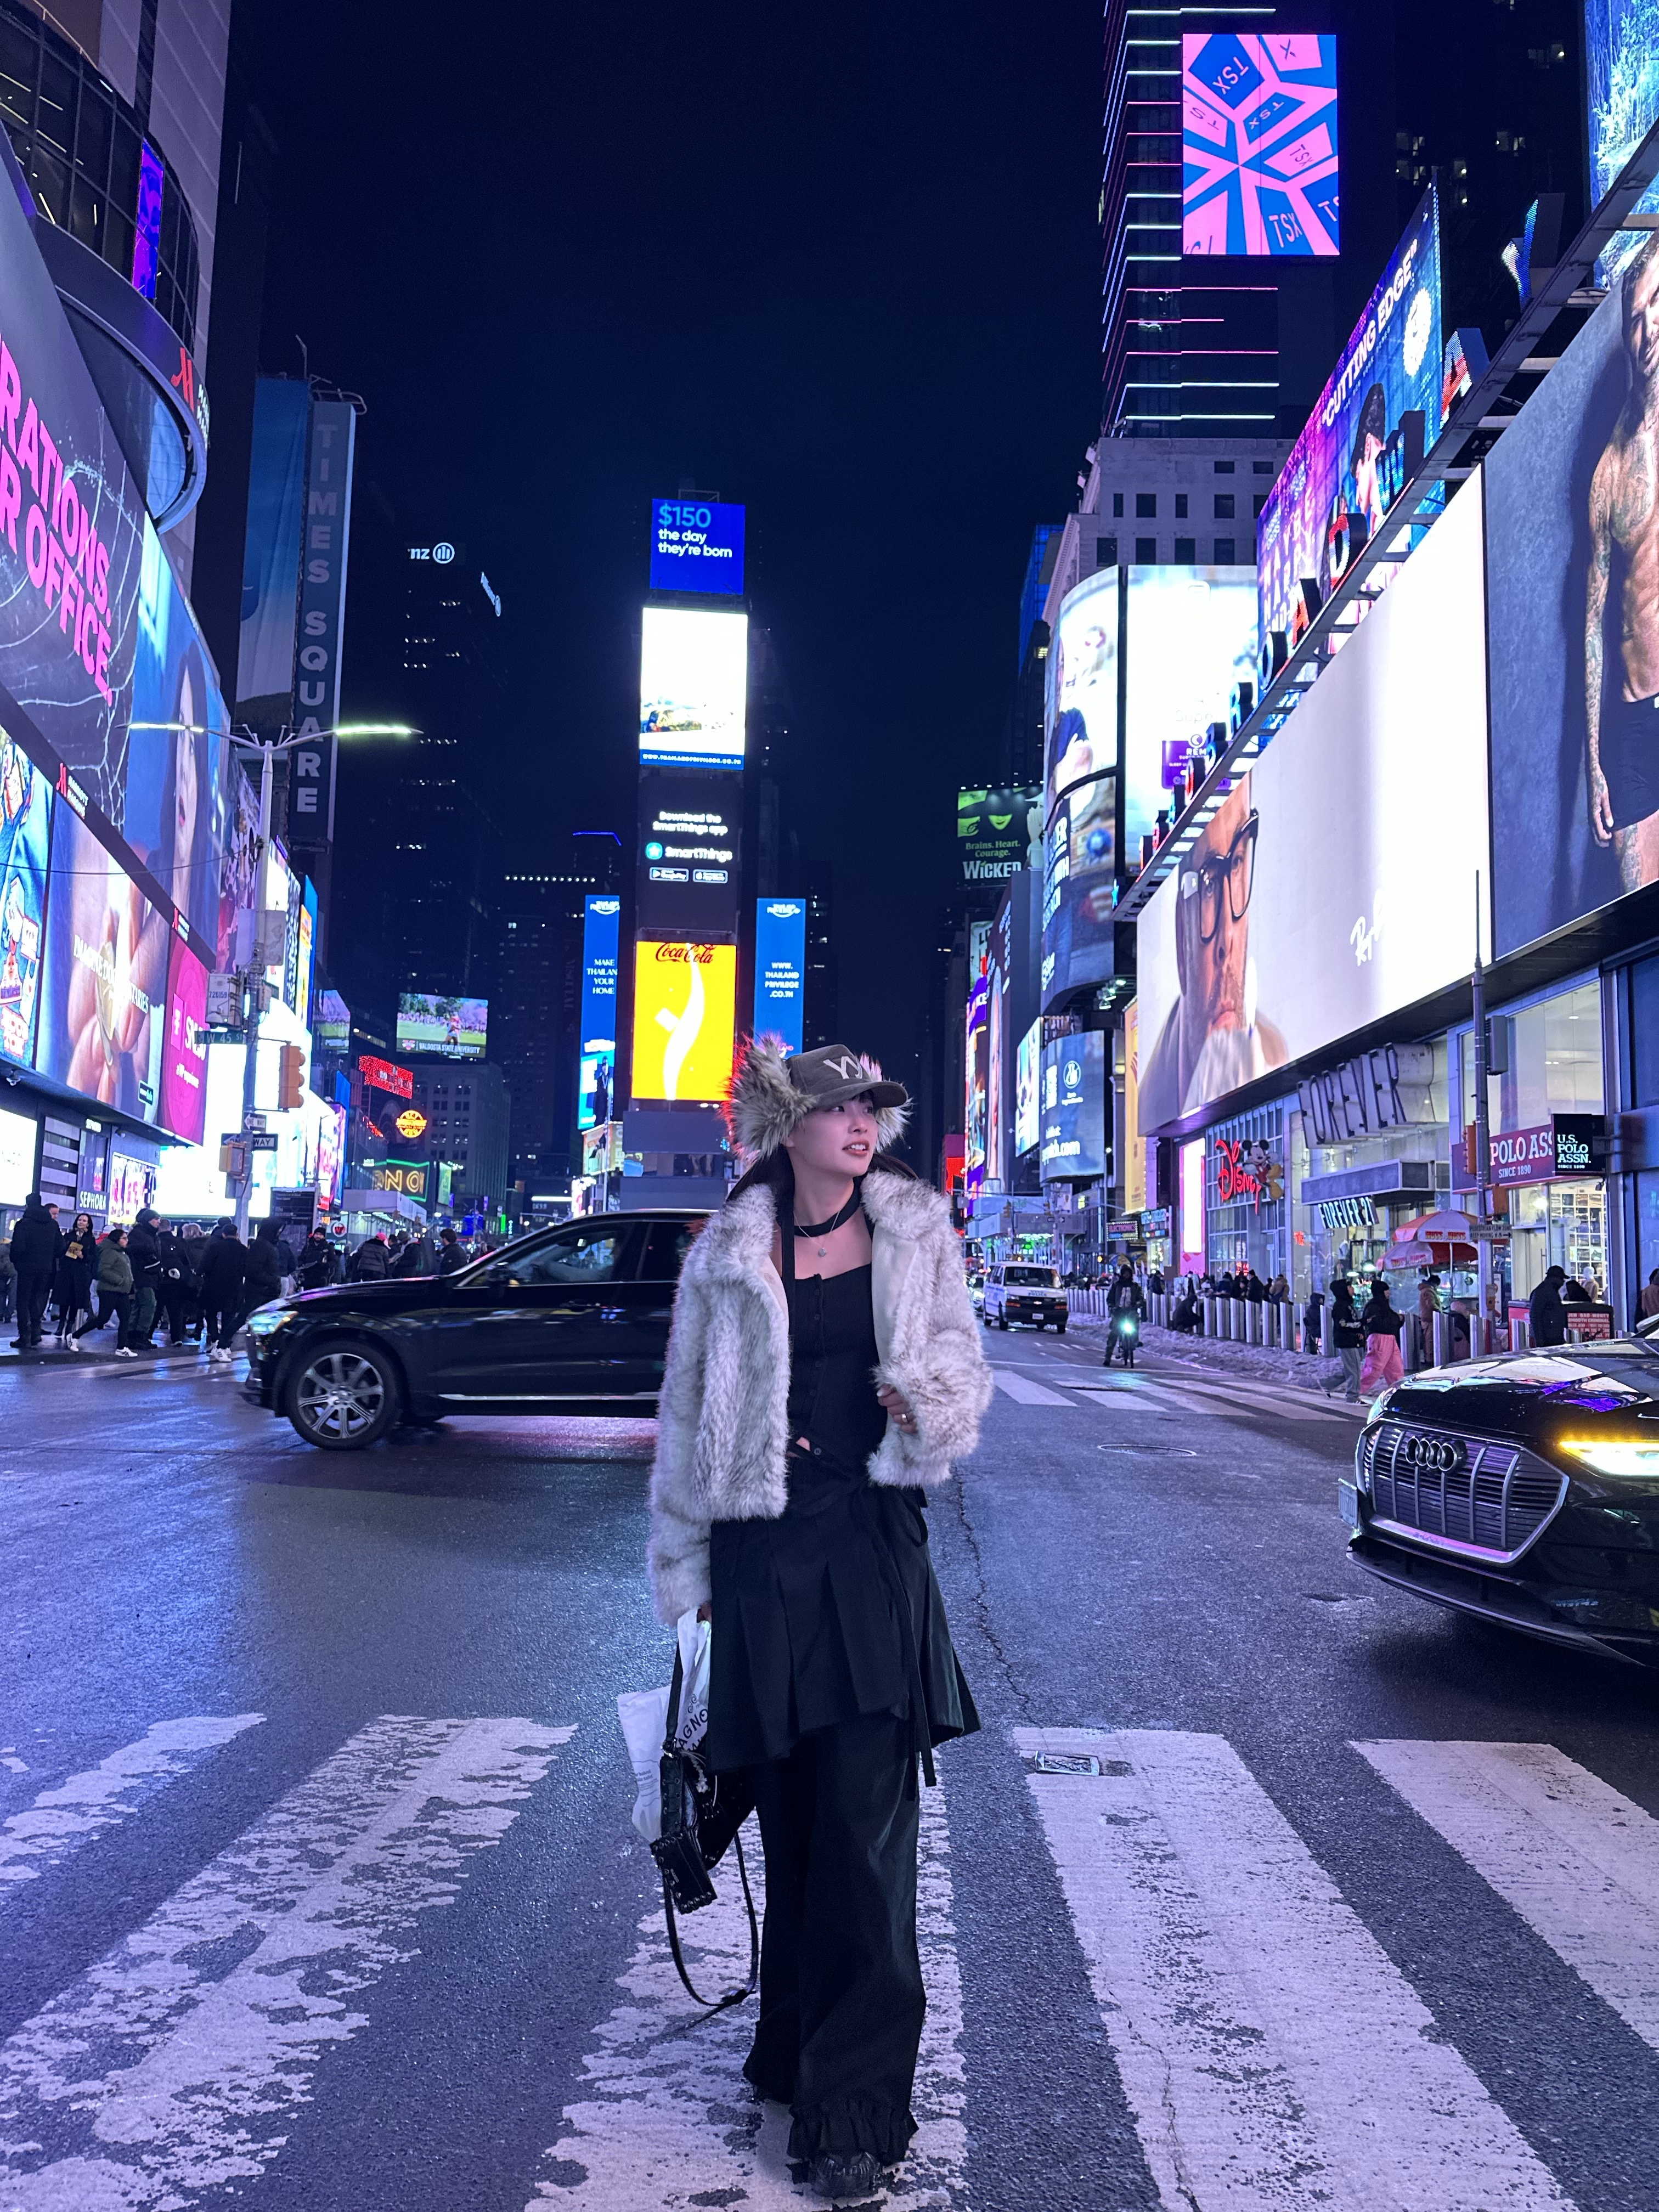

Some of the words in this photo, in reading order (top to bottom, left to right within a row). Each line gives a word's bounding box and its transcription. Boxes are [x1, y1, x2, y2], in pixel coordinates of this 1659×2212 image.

[1212, 56, 1250, 95] TSX
[1248, 101, 1285, 130] TSX
[1289, 144, 1314, 167] TSX
[1268, 212, 1303, 248] TSX
[308, 424, 338, 585] TIMES
[658, 503, 712, 528] $150
[658, 528, 680, 541] the
[682, 529, 707, 544] day
[658, 541, 702, 557] they're
[703, 545, 732, 558] born
[297, 611, 328, 814] SQUARE
[659, 811, 706, 822] Download
[706, 814, 722, 823] the
[709, 825, 728, 836] app
[966, 841, 994, 850] Brains.
[995, 840, 1021, 848] Heart.
[975, 849, 1011, 858] Courage.
[665, 846, 733, 863] SmartThings
[207, 1034, 216, 1042] W
[219, 1033, 232, 1043] 45
[441, 1044, 455, 1052] STATE
[1557, 1134, 1578, 1144] U.S.
[1490, 1136, 1526, 1166] POLO
[1558, 1144, 1589, 1153] POLO
[1558, 1154, 1592, 1164] ASSN.
[1498, 1166, 1516, 1178] SINCE
[1517, 1164, 1532, 1175] 1890
[80, 1190, 106, 1210] SEPHORA
[1318, 1198, 1363, 1229] FOREVER
[1359, 1196, 1375, 1226] 21
